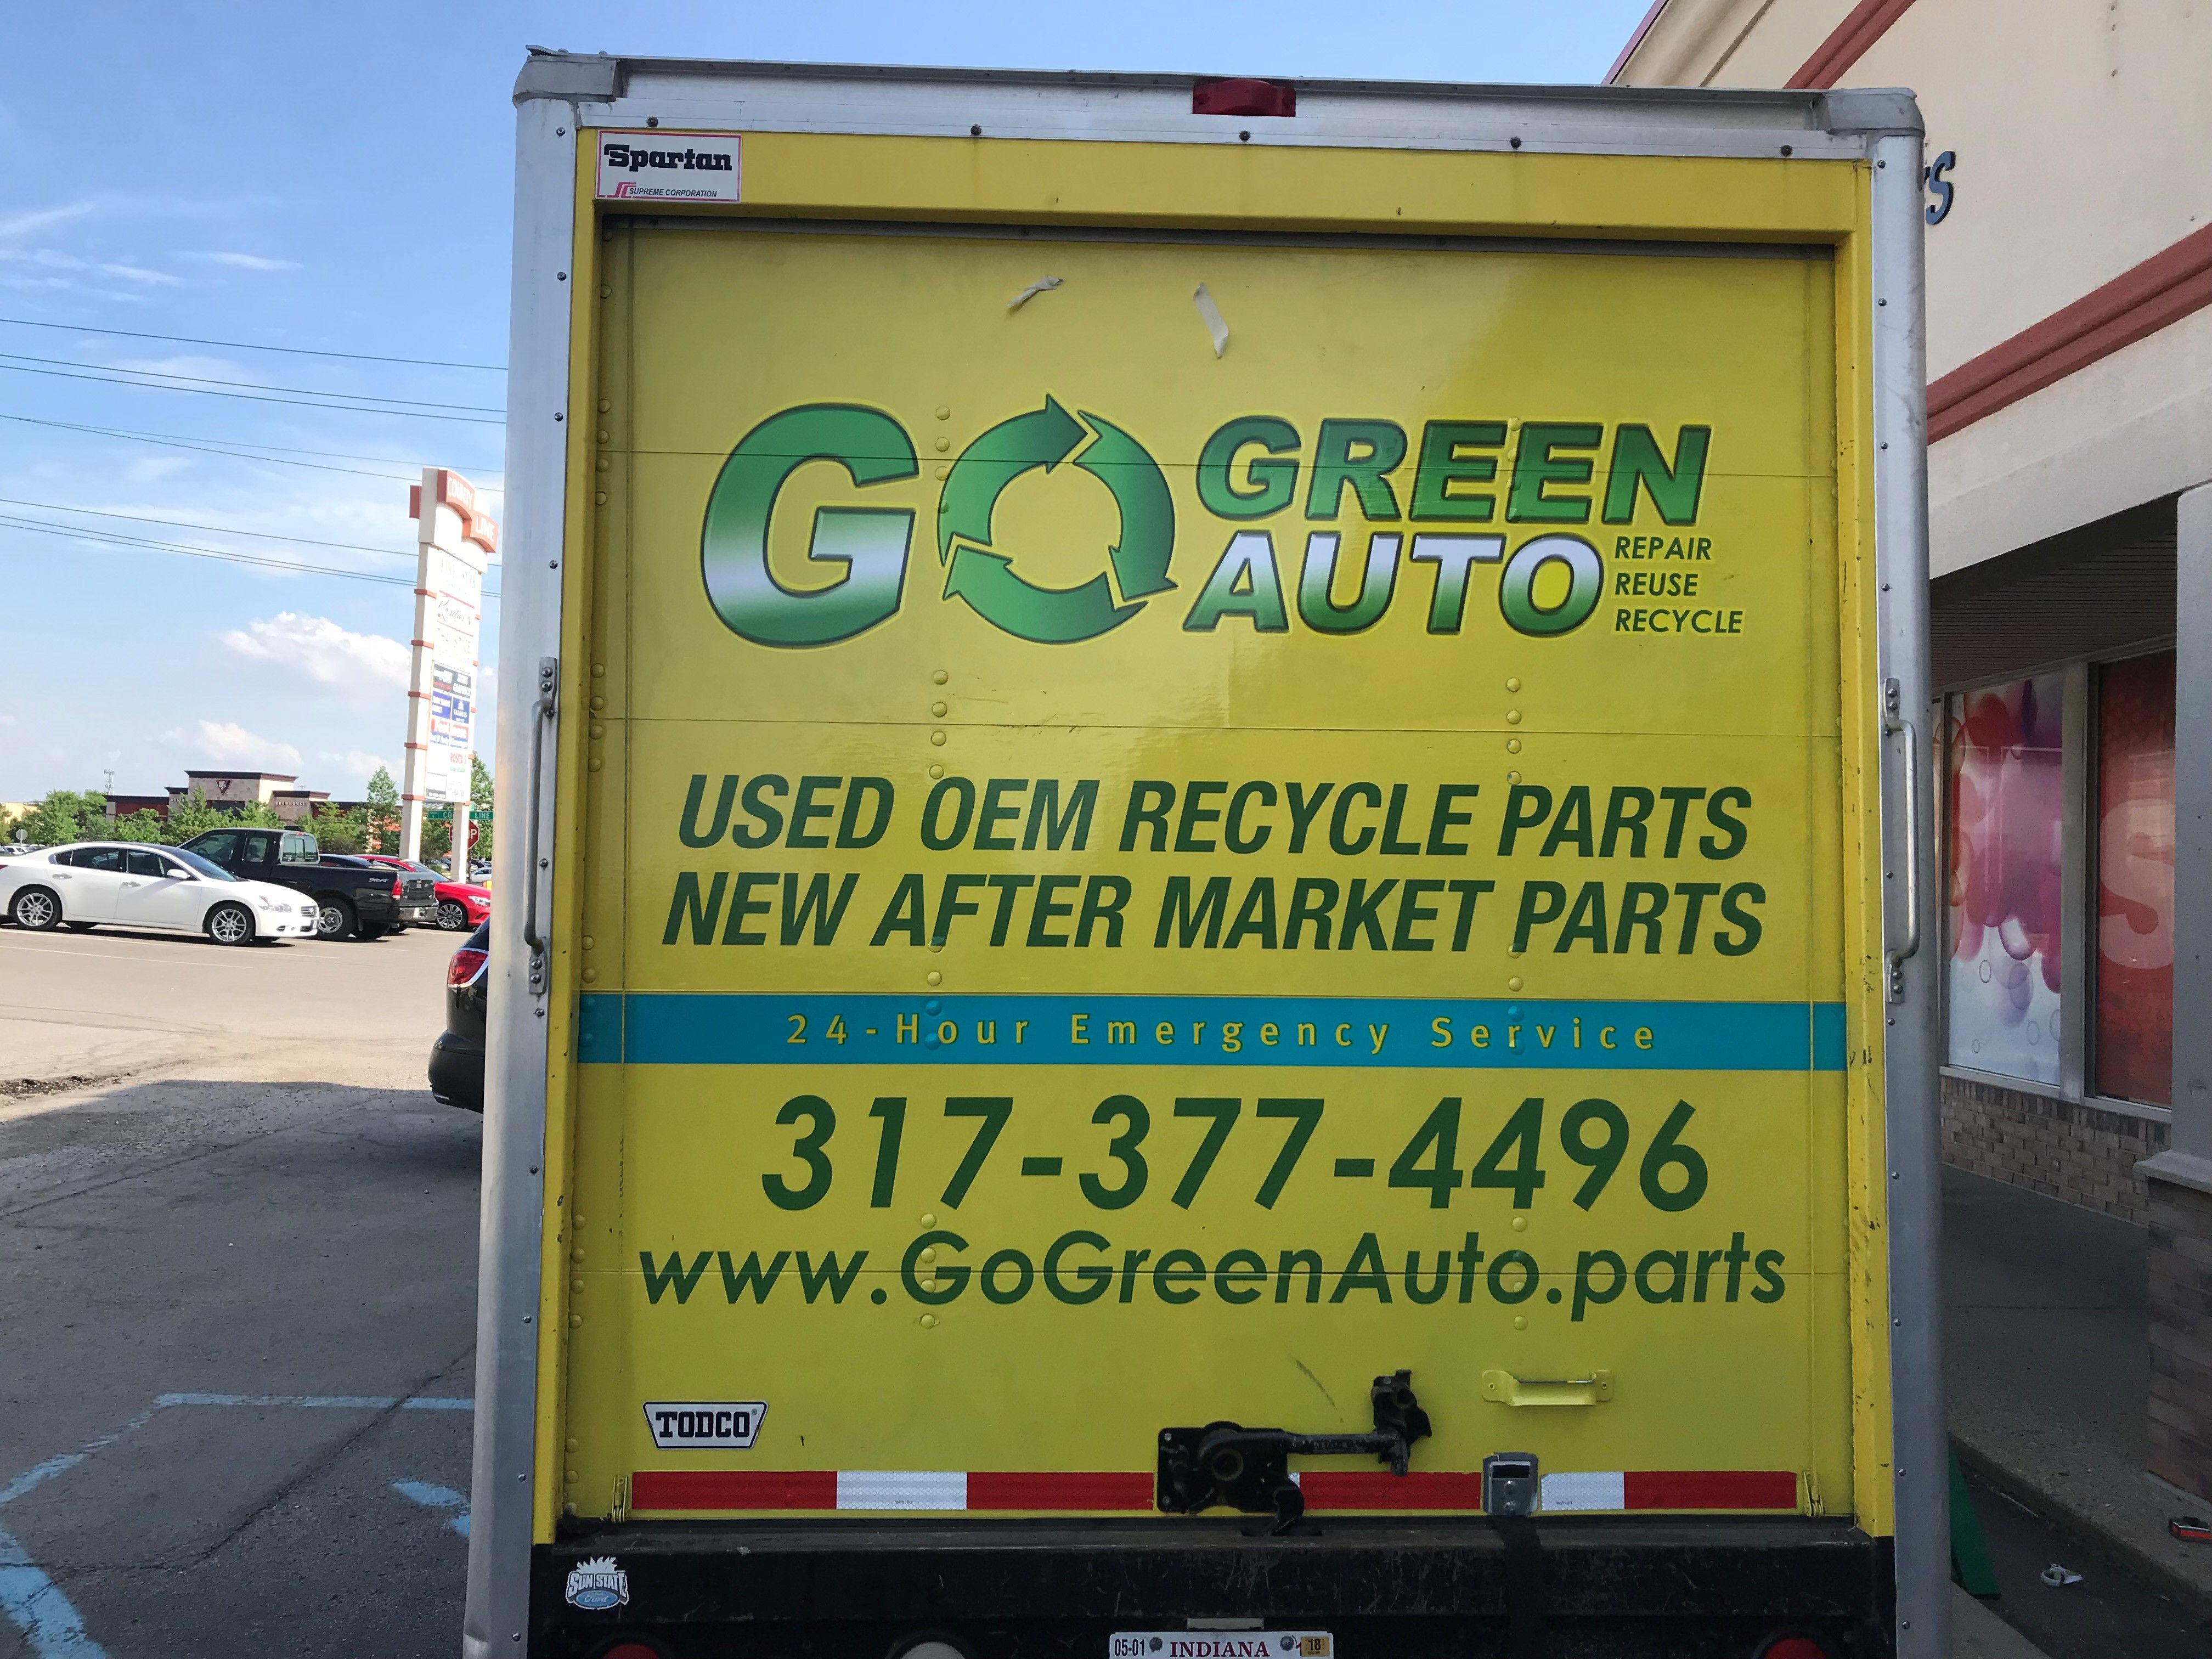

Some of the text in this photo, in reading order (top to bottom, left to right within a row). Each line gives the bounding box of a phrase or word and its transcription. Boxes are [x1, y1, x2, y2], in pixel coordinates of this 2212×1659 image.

[603, 143, 732, 172] Spartan
[629, 187, 664, 196] SUPREME
[665, 189, 718, 198] CORPORATION
[1195, 415, 1712, 526] GREEN
[447, 476, 473, 510] COUNTY
[476, 515, 495, 543] LINE
[1615, 535, 1712, 560] REPAIR
[1182, 529, 1604, 635] AUTO
[1615, 572, 1699, 596] REUSE
[1615, 608, 1743, 633] RECYCLE
[679, 774, 1752, 860] USED OEM RECYCLE PARTS
[662, 871, 1767, 956] NEW AFTER MARKET PARTS
[787, 1013, 1654, 1055] 24-Hour Emergency Service
[761, 1094, 1708, 1212] 317-377-4496
[639, 1230, 1786, 1322] www.GoGreenAuto.parts
[655, 1411, 751, 1438] TODCO
[1114, 1639, 1145, 1657] 05-01
[1170, 1641, 1271, 1657] INDIANA
[1308, 1638, 1321, 1651] 18
